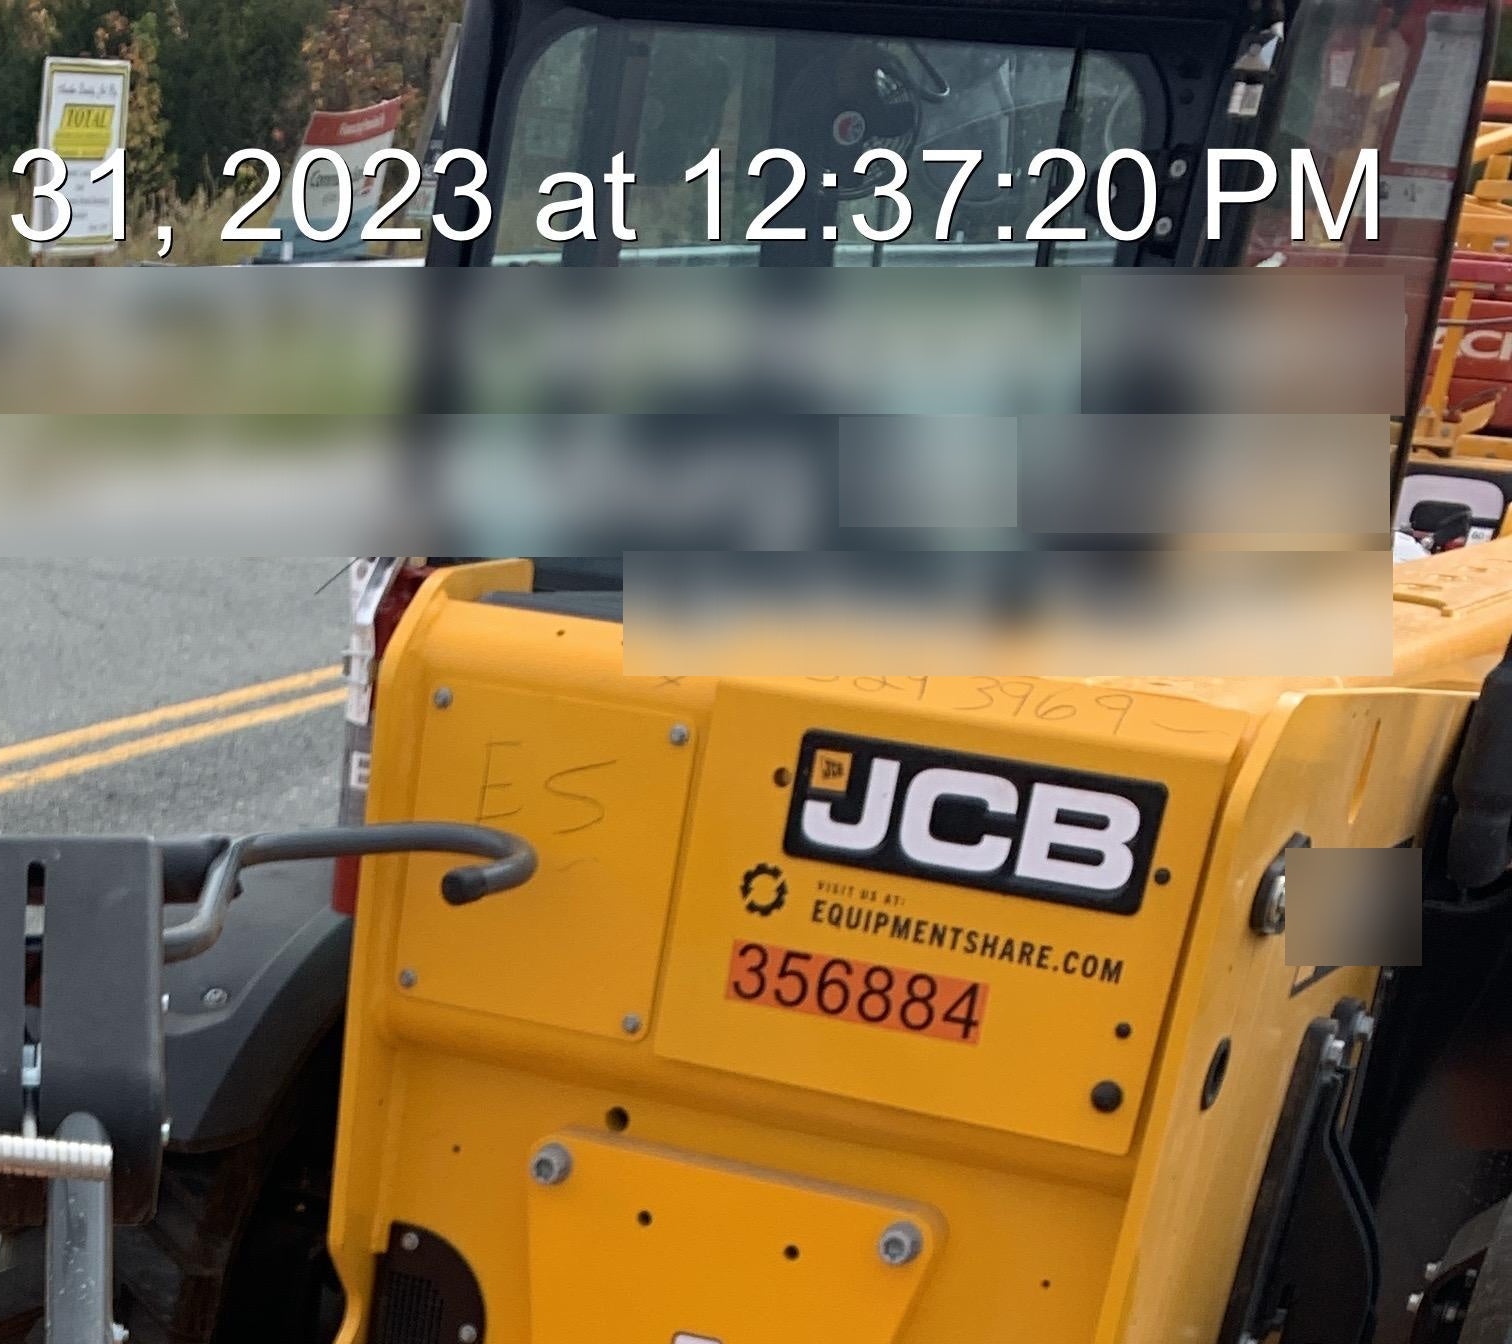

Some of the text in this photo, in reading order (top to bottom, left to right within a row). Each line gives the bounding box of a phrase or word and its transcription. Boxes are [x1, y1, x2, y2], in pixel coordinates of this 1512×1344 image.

[67, 108, 108, 129] TOTAL
[476, 740, 619, 836] ES
[800, 756, 1142, 891] JCB
[817, 880, 855, 898] VISIT
[859, 889, 877, 901] US
[811, 899, 1125, 986] EQUIPMENTSHARE.COM
[732, 942, 981, 1041] 356884
